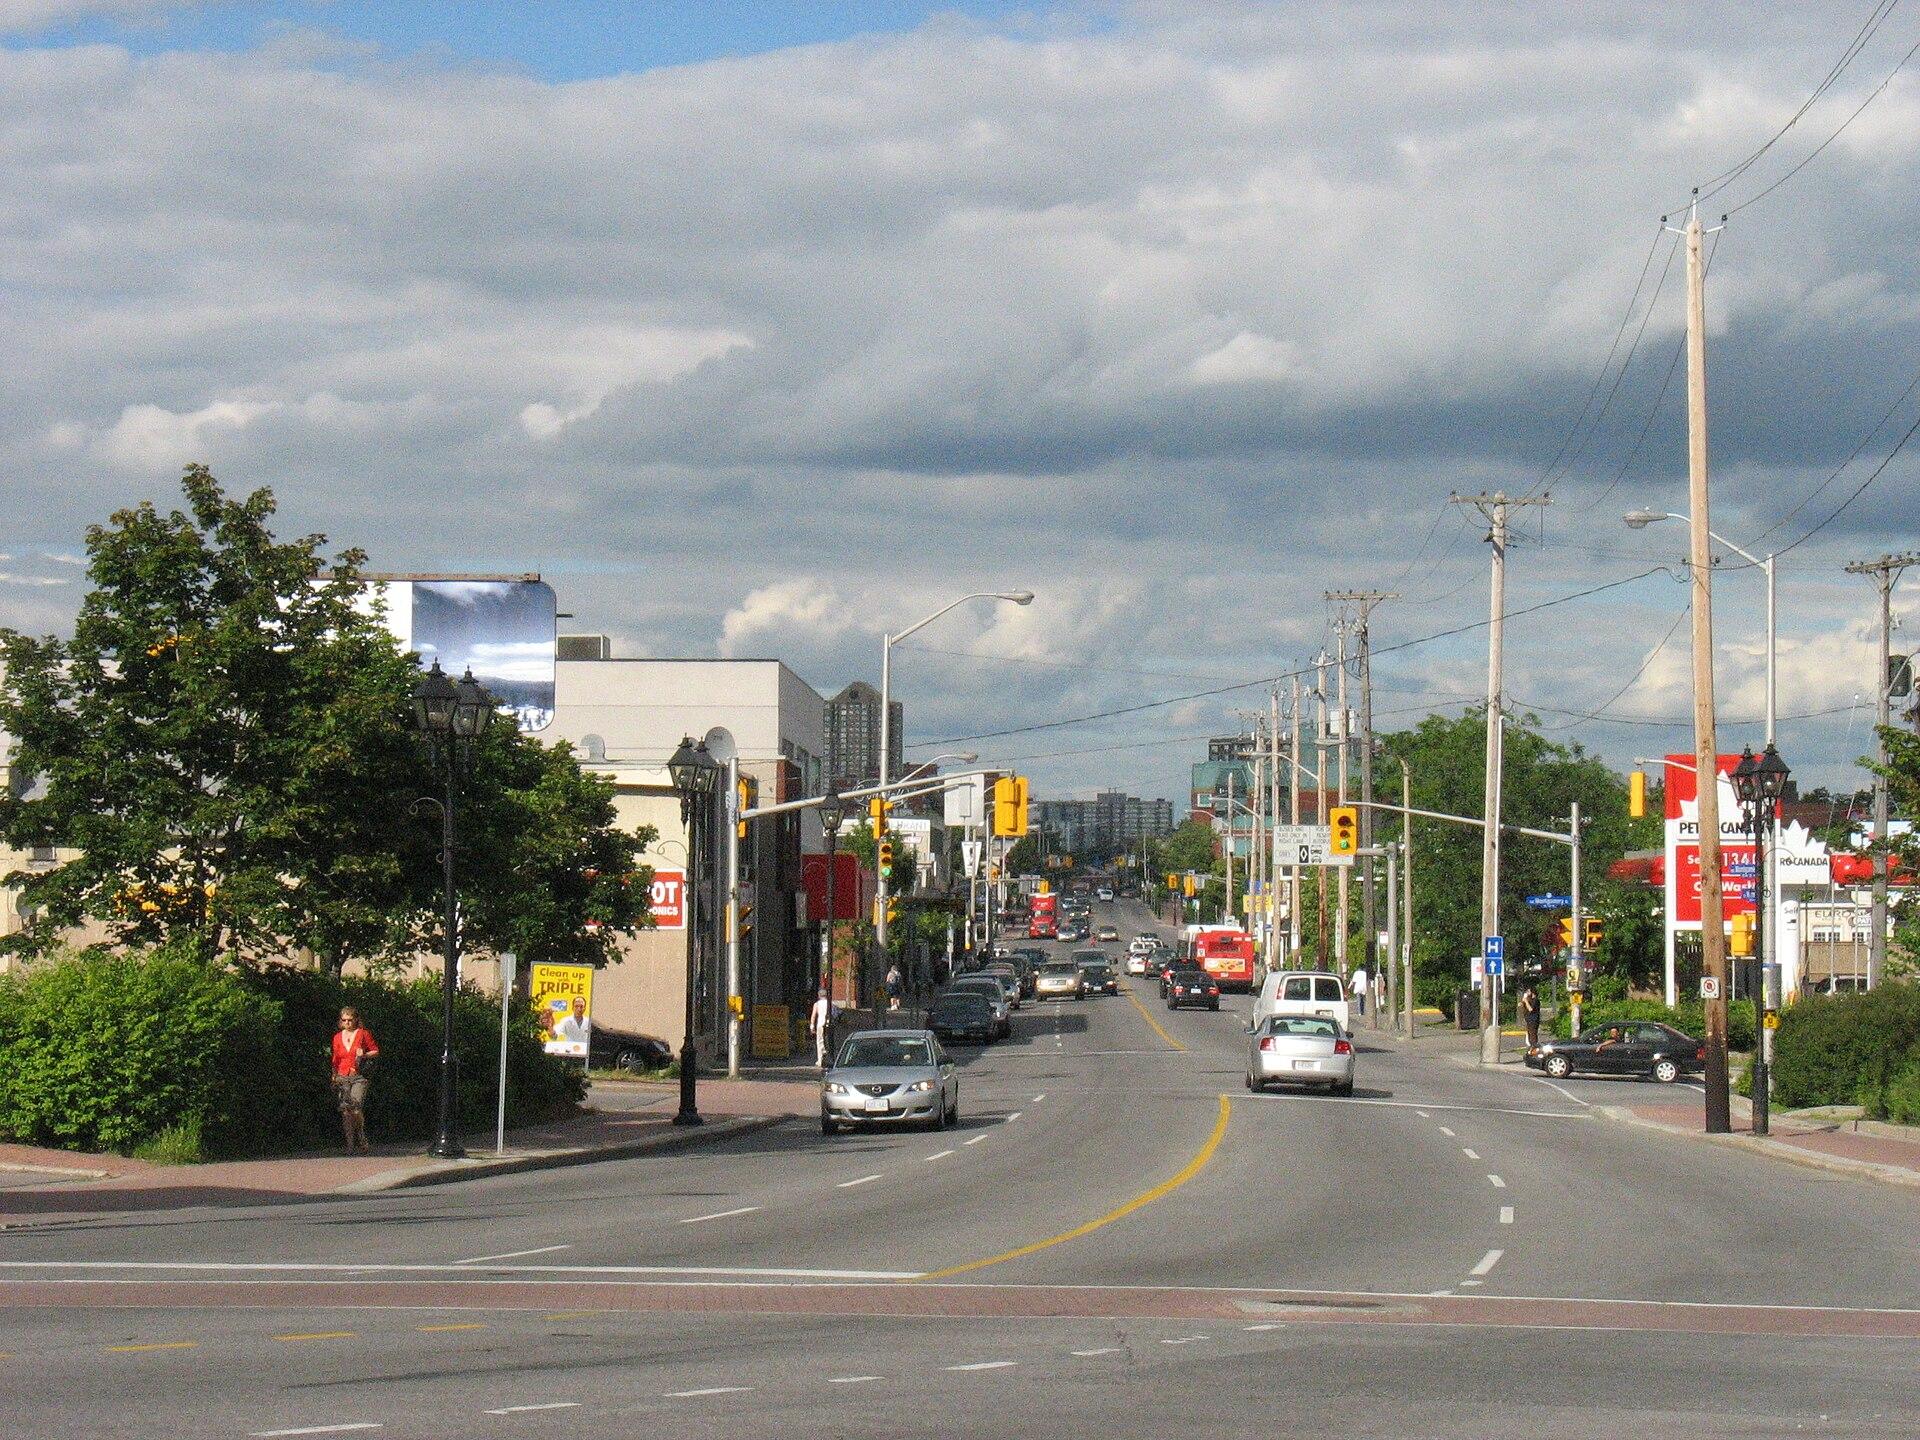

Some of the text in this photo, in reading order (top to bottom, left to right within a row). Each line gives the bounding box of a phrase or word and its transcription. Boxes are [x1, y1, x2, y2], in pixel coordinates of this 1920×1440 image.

[1487, 940, 1499, 954] H
[539, 967, 569, 978] Clean
[571, 972, 586, 981] up
[539, 981, 585, 995] TRIPLE
